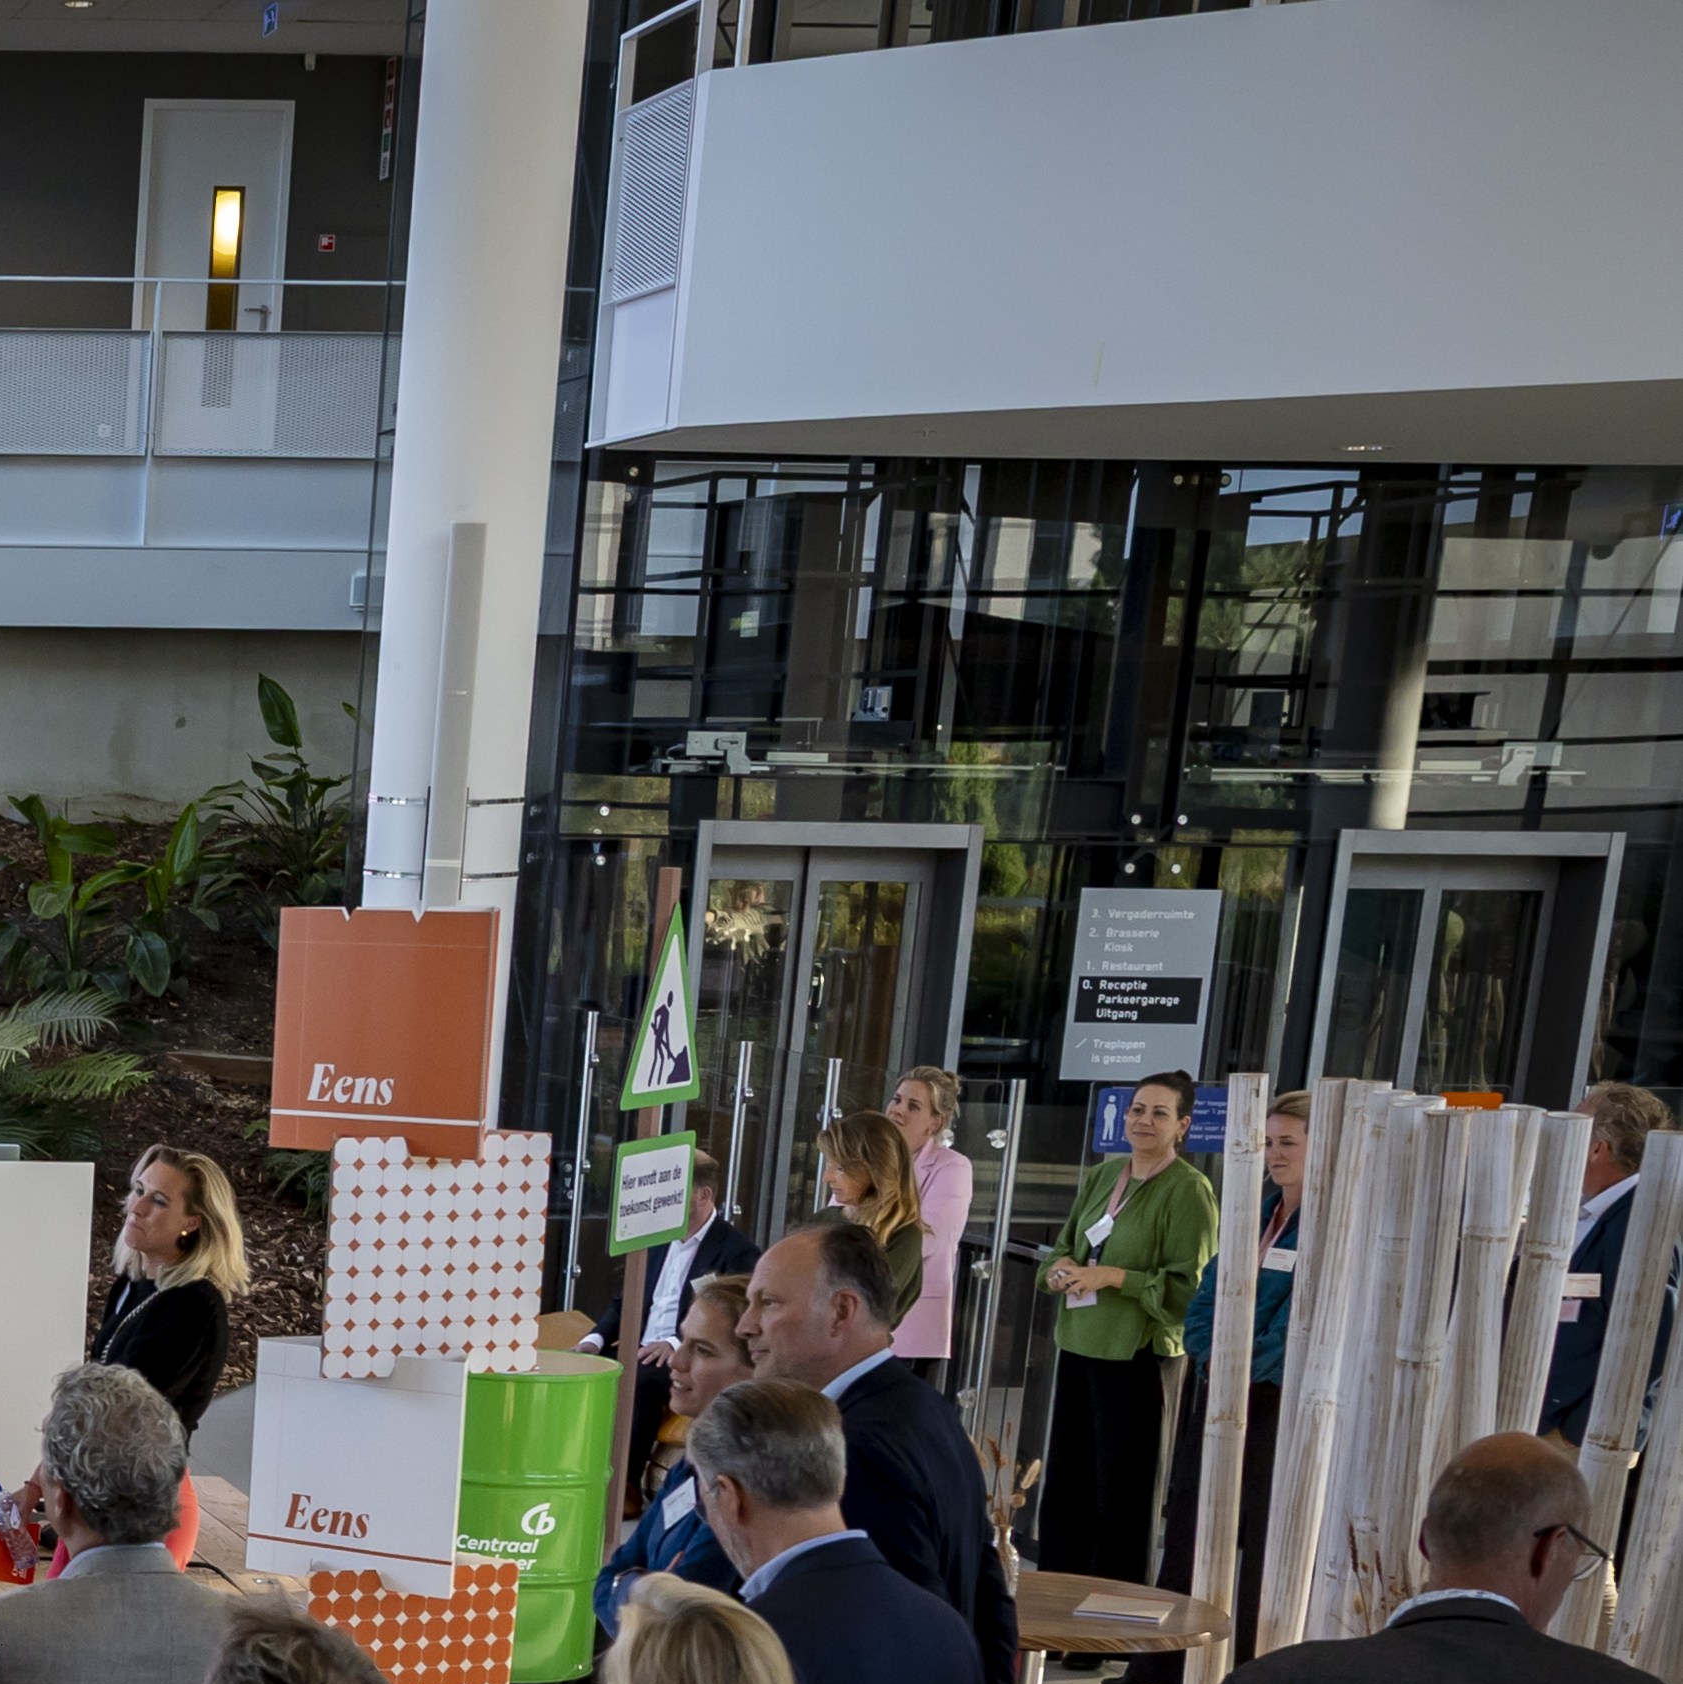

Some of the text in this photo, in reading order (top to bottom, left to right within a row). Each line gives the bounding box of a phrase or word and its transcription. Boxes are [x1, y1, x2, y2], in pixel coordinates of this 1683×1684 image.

[1091, 908, 1195, 921] 3. Vergaderruimte
[1088, 927, 1160, 939] 2. Brasserie
[1104, 942, 1134, 953] Kiosk
[1086, 960, 1164, 972] 1. Restaurant
[1082, 979, 1148, 992] 0. Receptie
[1097, 994, 1180, 1007] Parkeergarage
[1095, 1008, 1138, 1021] Uitgang
[1093, 1038, 1146, 1051] Traplopen
[1090, 1053, 1141, 1065] is gezond
[306, 1062, 395, 1106] Eens
[622, 1165, 681, 1191] Hier wordt aan de
[620, 1196, 651, 1217] toekomst
[283, 1493, 371, 1540] Eens
[455, 1534, 540, 1554] Centraal
